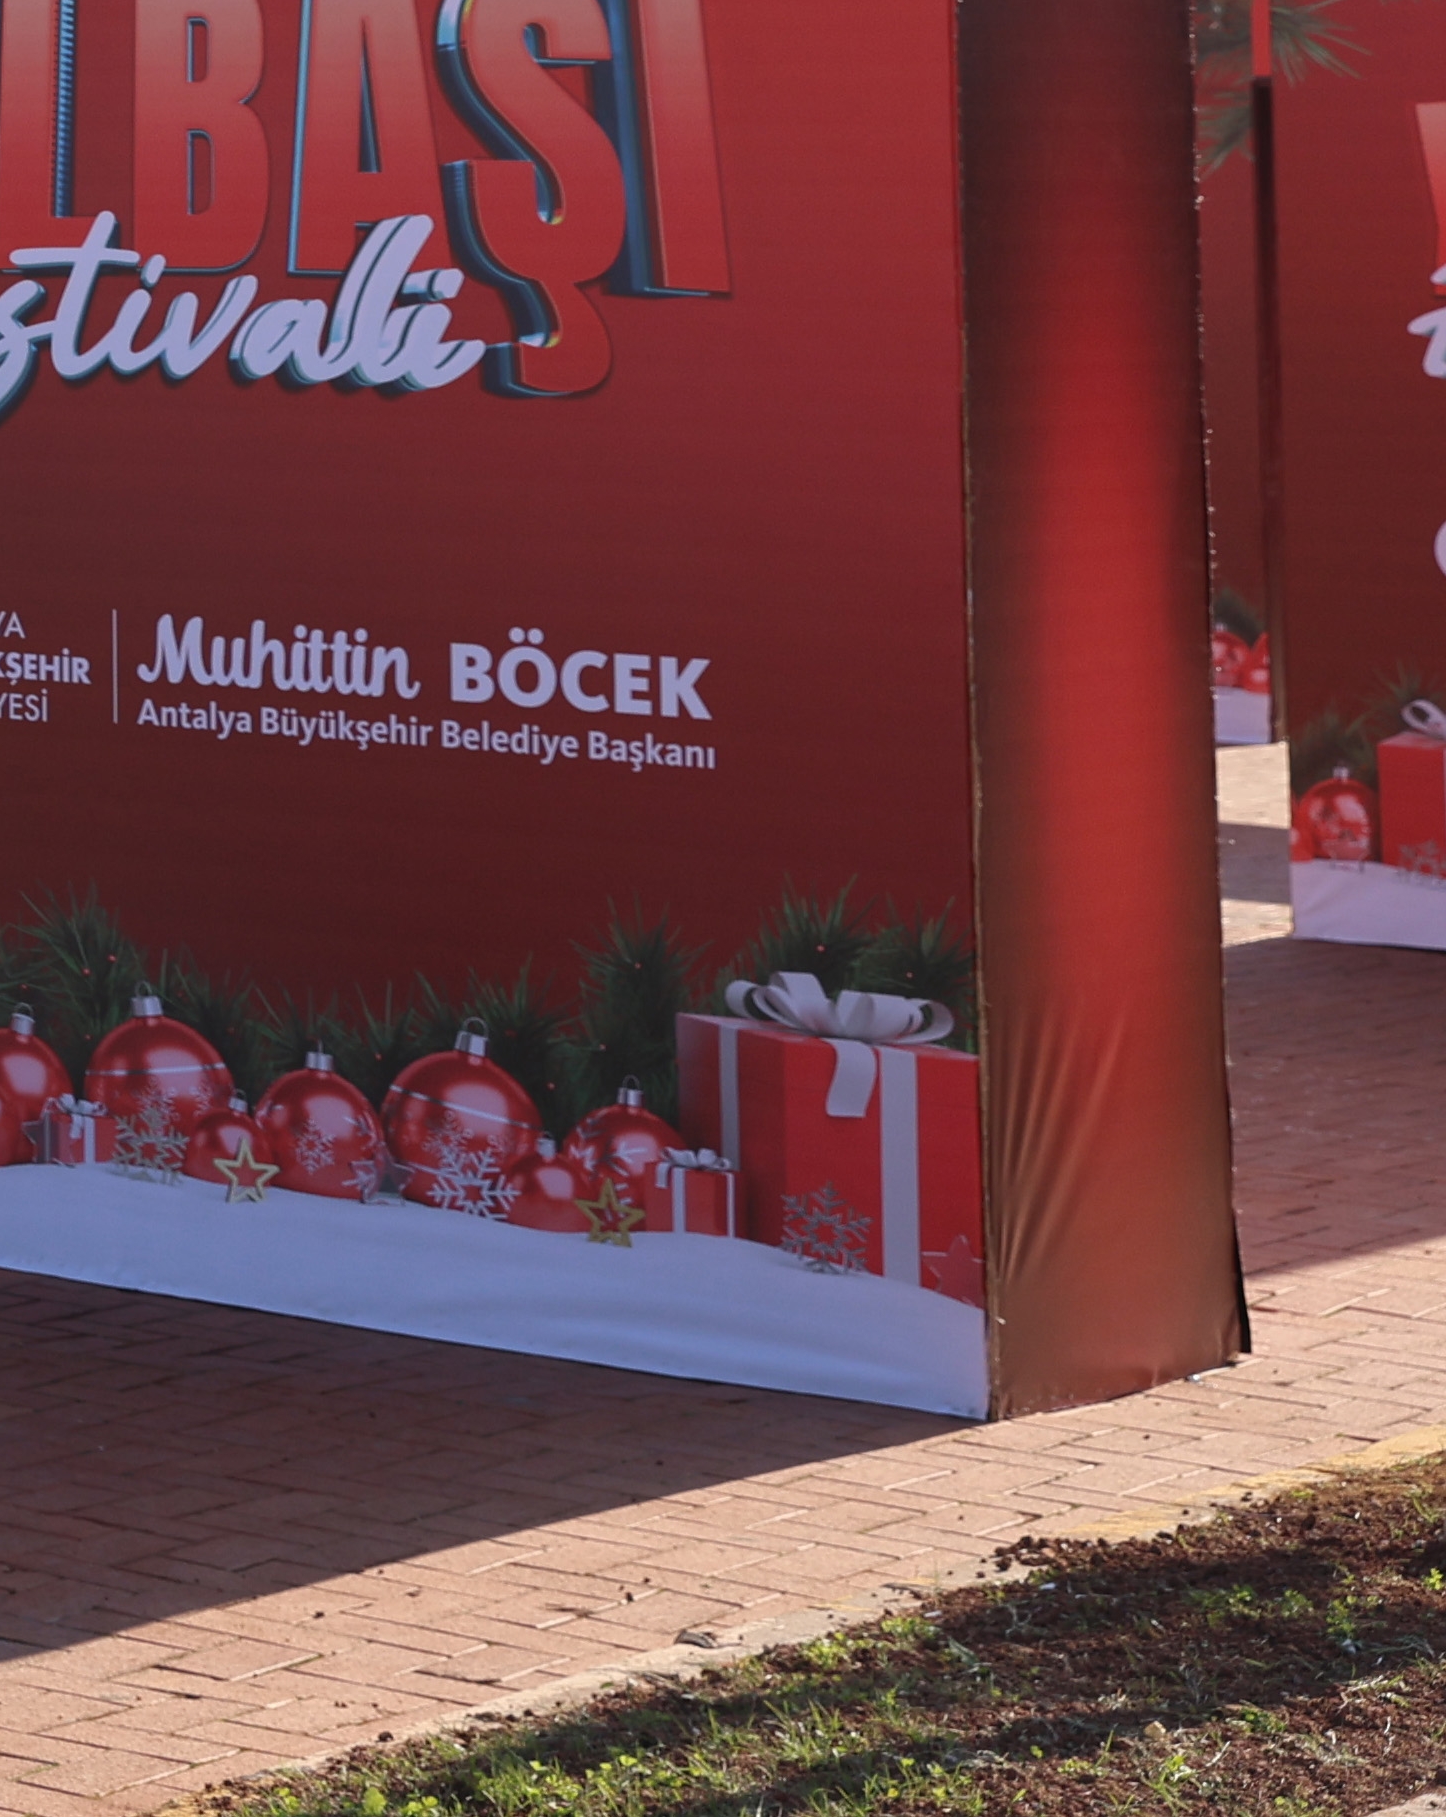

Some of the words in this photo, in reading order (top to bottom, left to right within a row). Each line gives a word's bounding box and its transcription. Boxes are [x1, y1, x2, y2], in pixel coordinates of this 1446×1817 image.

[137, 614, 420, 699] Muhittin
[449, 626, 713, 721] BÖCEK
[137, 698, 252, 740] Antalya
[261, 707, 433, 751] Büyükşehir
[441, 719, 579, 765] Belediye
[588, 731, 716, 772] Başkanı
